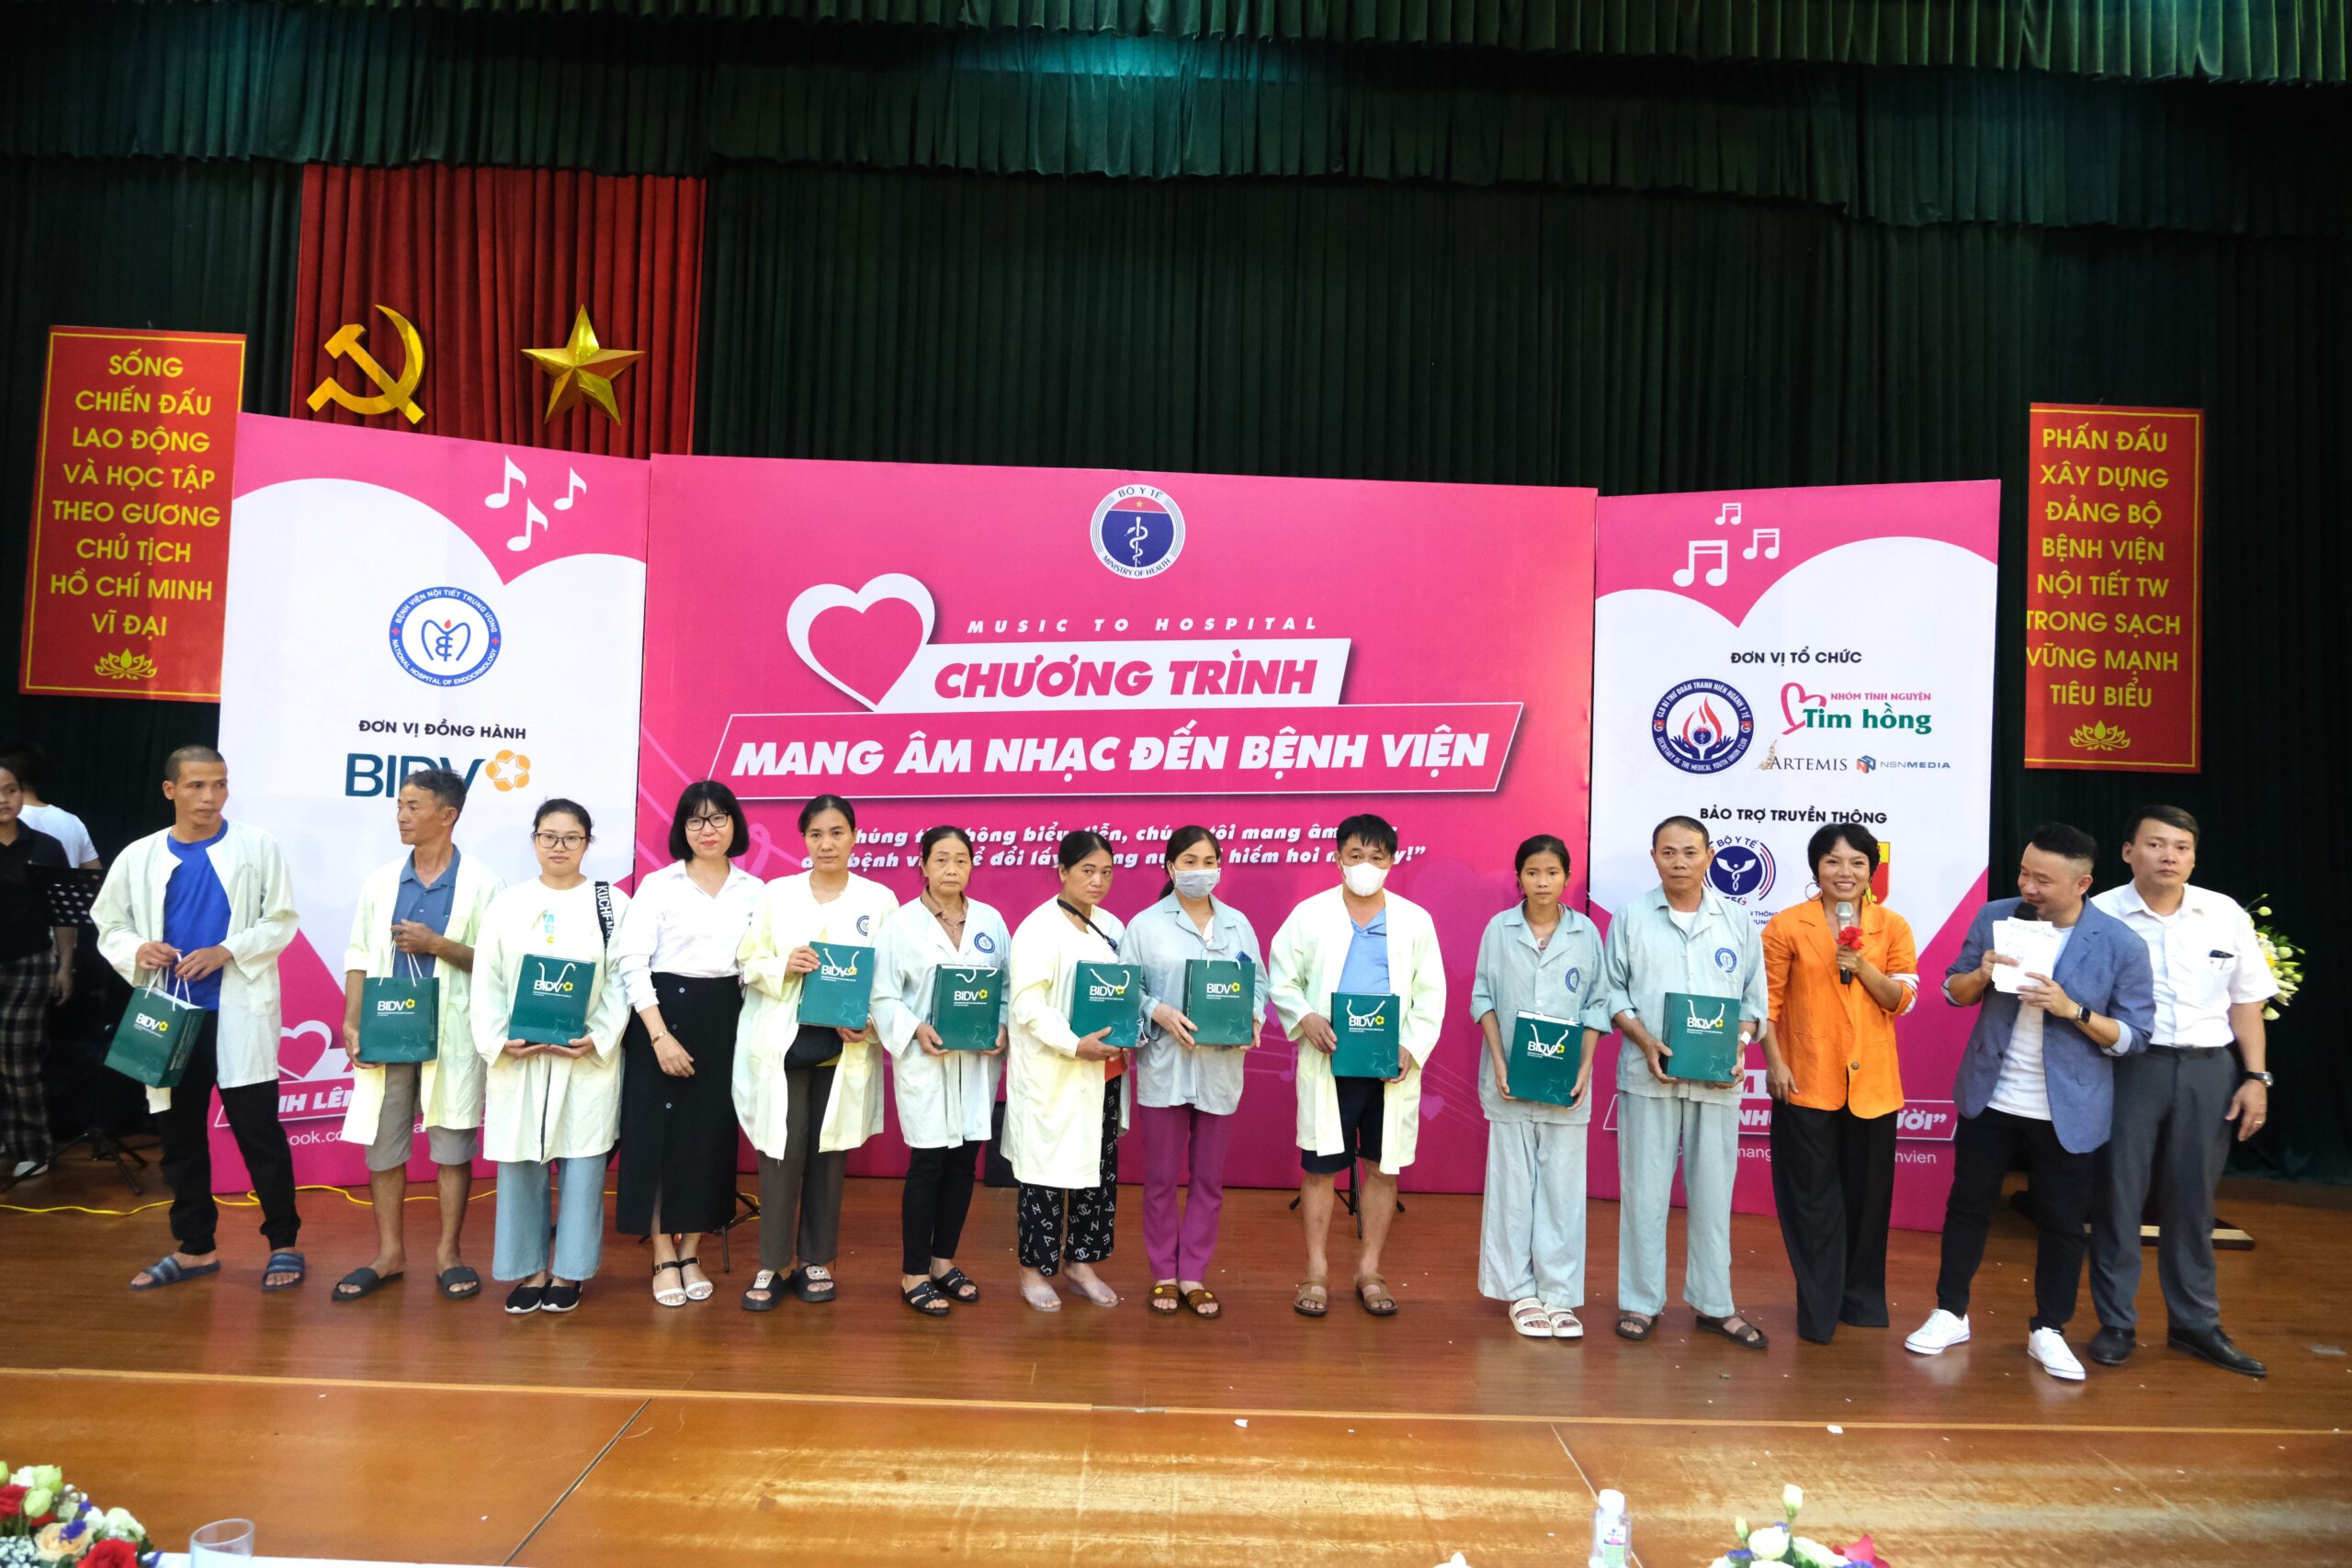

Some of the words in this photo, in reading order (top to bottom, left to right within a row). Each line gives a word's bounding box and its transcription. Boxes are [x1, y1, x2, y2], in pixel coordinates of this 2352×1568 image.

[108, 349, 183, 378] SỐNG
[75, 385, 150, 413] CHIẾN
[158, 388, 211, 415] ĐẤU
[73, 427, 123, 448] LAO
[130, 426, 209, 455] ĐỘNG
[2043, 423, 2108, 450] PHẤN
[2116, 424, 2166, 452] ĐẤU
[63, 458, 98, 484] VÀ
[107, 466, 164, 491] HỌC
[171, 465, 215, 493] TẬP
[2041, 461, 2090, 485] XÂY
[2098, 466, 2168, 491] DỰNG
[52, 501, 114, 521] THEO
[122, 502, 220, 526] GƯƠNG
[2045, 494, 2120, 523] ĐẢNG
[2128, 501, 2161, 528] BỘ
[77, 533, 129, 560] CHỦ
[137, 538, 190, 566] TỊCH
[2042, 534, 2102, 561] BỆNH
[2110, 536, 2164, 565] VIỆN
[1102, 555, 1133, 576] MINISTRY
[1146, 558, 1170, 575] HEALTH
[51, 568, 88, 595] HỒ
[96, 573, 139, 598] CHÍ
[148, 577, 211, 601] MINH
[2038, 570, 2081, 598] NỘI
[2089, 569, 2131, 596] TIẾT
[2136, 578, 2169, 597] TW
[463, 593, 487, 613] TRUNG
[92, 610, 115, 634] VĨ
[124, 614, 166, 640] ĐẠI
[967, 619, 1068, 634] MUSIC
[1094, 618, 1129, 632] TO
[1156, 617, 1317, 632] HOSPITAL
[2027, 610, 2108, 633] TRONG
[2115, 614, 2180, 637] SẠCH
[1730, 651, 1765, 663] ĐƠN
[1770, 652, 1785, 666] VỊ
[1790, 646, 1811, 663] TỔ
[1815, 649, 1862, 663] CHỨC
[2026, 643, 2097, 669] VỮNG
[2105, 649, 2177, 674] MẠNH
[410, 667, 441, 685] HOSPITAL
[934, 653, 1153, 699] CHƯƠNG
[1169, 649, 1317, 695] TRÌNH
[1830, 692, 1860, 701] NHÓM
[1865, 692, 1887, 701] TÌNH
[1891, 691, 1931, 702] NGUYỆN
[2051, 681, 2095, 705] TIÊU
[2104, 677, 2152, 707] BIỂU
[359, 719, 397, 734] ĐƠN
[403, 722, 419, 738] VỊ
[424, 718, 475, 737] ĐỒNG
[481, 724, 526, 739] HÀNH
[1803, 708, 1851, 728] Tim
[1862, 703, 1932, 735] hồng
[731, 740, 885, 776] MANG
[894, 730, 972, 774] ÂM
[984, 737, 1121, 782] NHẠC
[1129, 719, 1228, 771] ĐẾN
[1238, 726, 1369, 780] BỆNH
[1381, 724, 1489, 777] VIỆN
[1770, 756, 1848, 771] ARTEMIS
[1701, 805, 1732, 819] BẢO
[1737, 807, 1766, 822] TRỢ
[1771, 806, 1826, 823] TRUYỀN
[1831, 809, 1887, 824] THÔNG
[855, 828, 908, 847] húng
[965, 827, 1016, 845] hông
[1136, 825, 1172, 840] chú
[1241, 828, 1301, 842] mang
[1745, 838, 1759, 849] TẾ
[847, 852, 898, 872] bệnh
[990, 846, 1024, 865] đổi
[1228, 845, 1279, 863] hiếm
[1286, 847, 1319, 863] hoi
[534, 979, 563, 993] BIDV
[954, 991, 979, 1001] BIDV
[1090, 985, 1115, 997] BIDV
[1206, 983, 1232, 994] BIDV
[377, 1000, 405, 1011] BIDV
[135, 1012, 160, 1030] BIDV
[1349, 1016, 1374, 1027] BIDV
